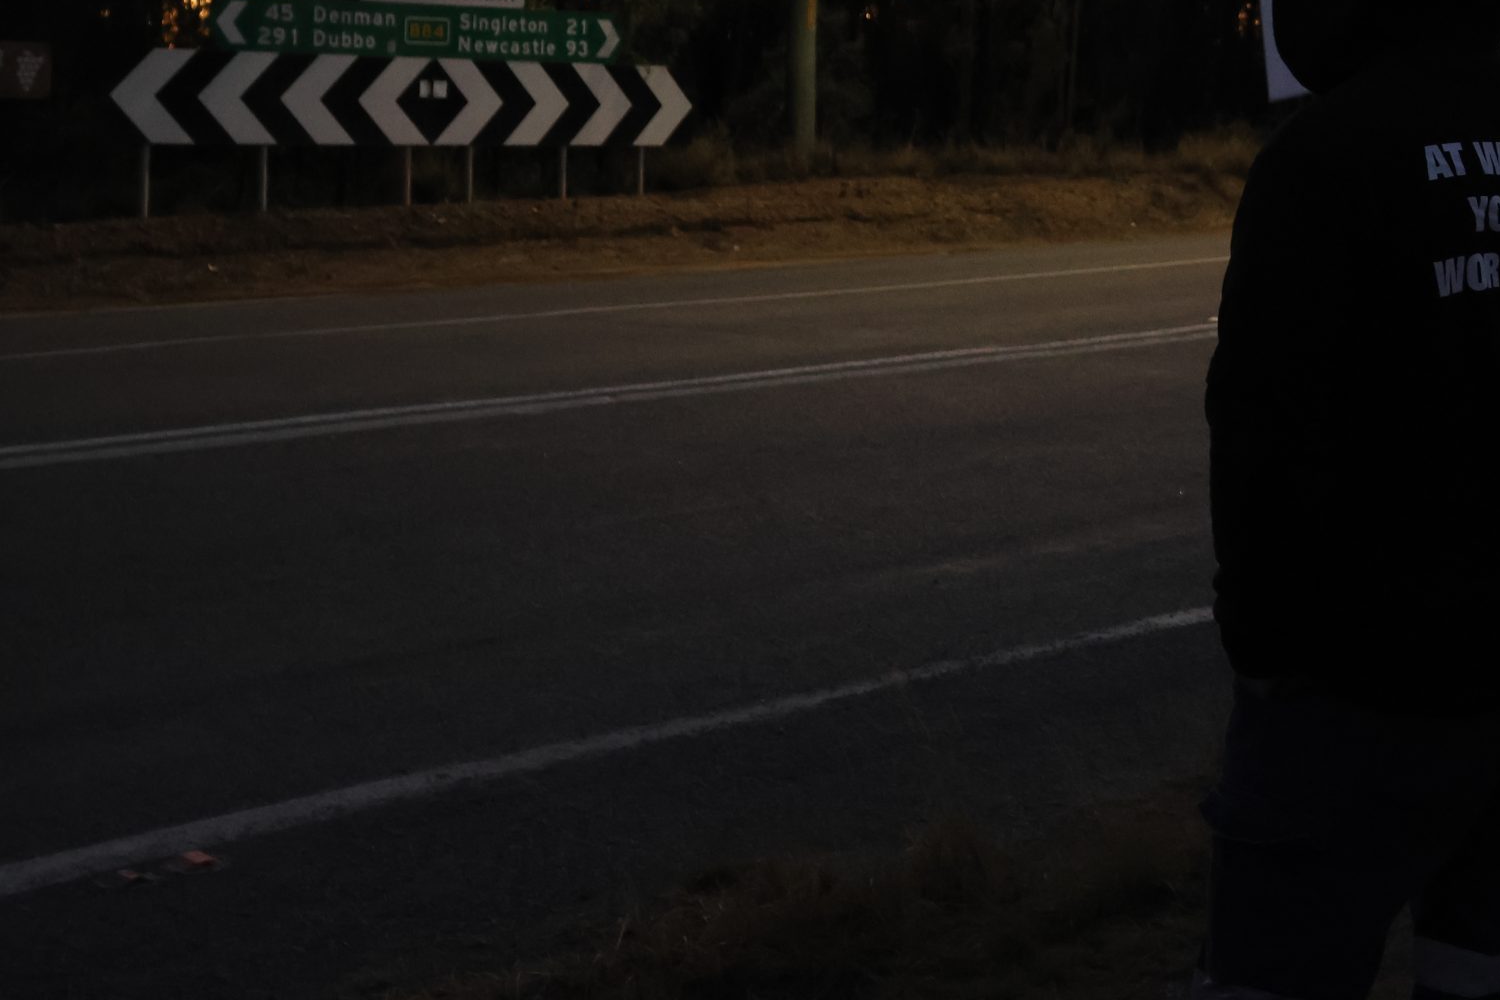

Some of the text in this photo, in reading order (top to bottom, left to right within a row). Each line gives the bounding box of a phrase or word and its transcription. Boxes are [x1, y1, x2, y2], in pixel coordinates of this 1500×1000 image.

[265, 3, 396, 26] 45 Denman
[459, 12, 588, 35] Singleton 21
[257, 26, 376, 49] 291 Dubbo
[457, 36, 588, 57] Newcastle 93
[1424, 143, 1467, 181] AT
